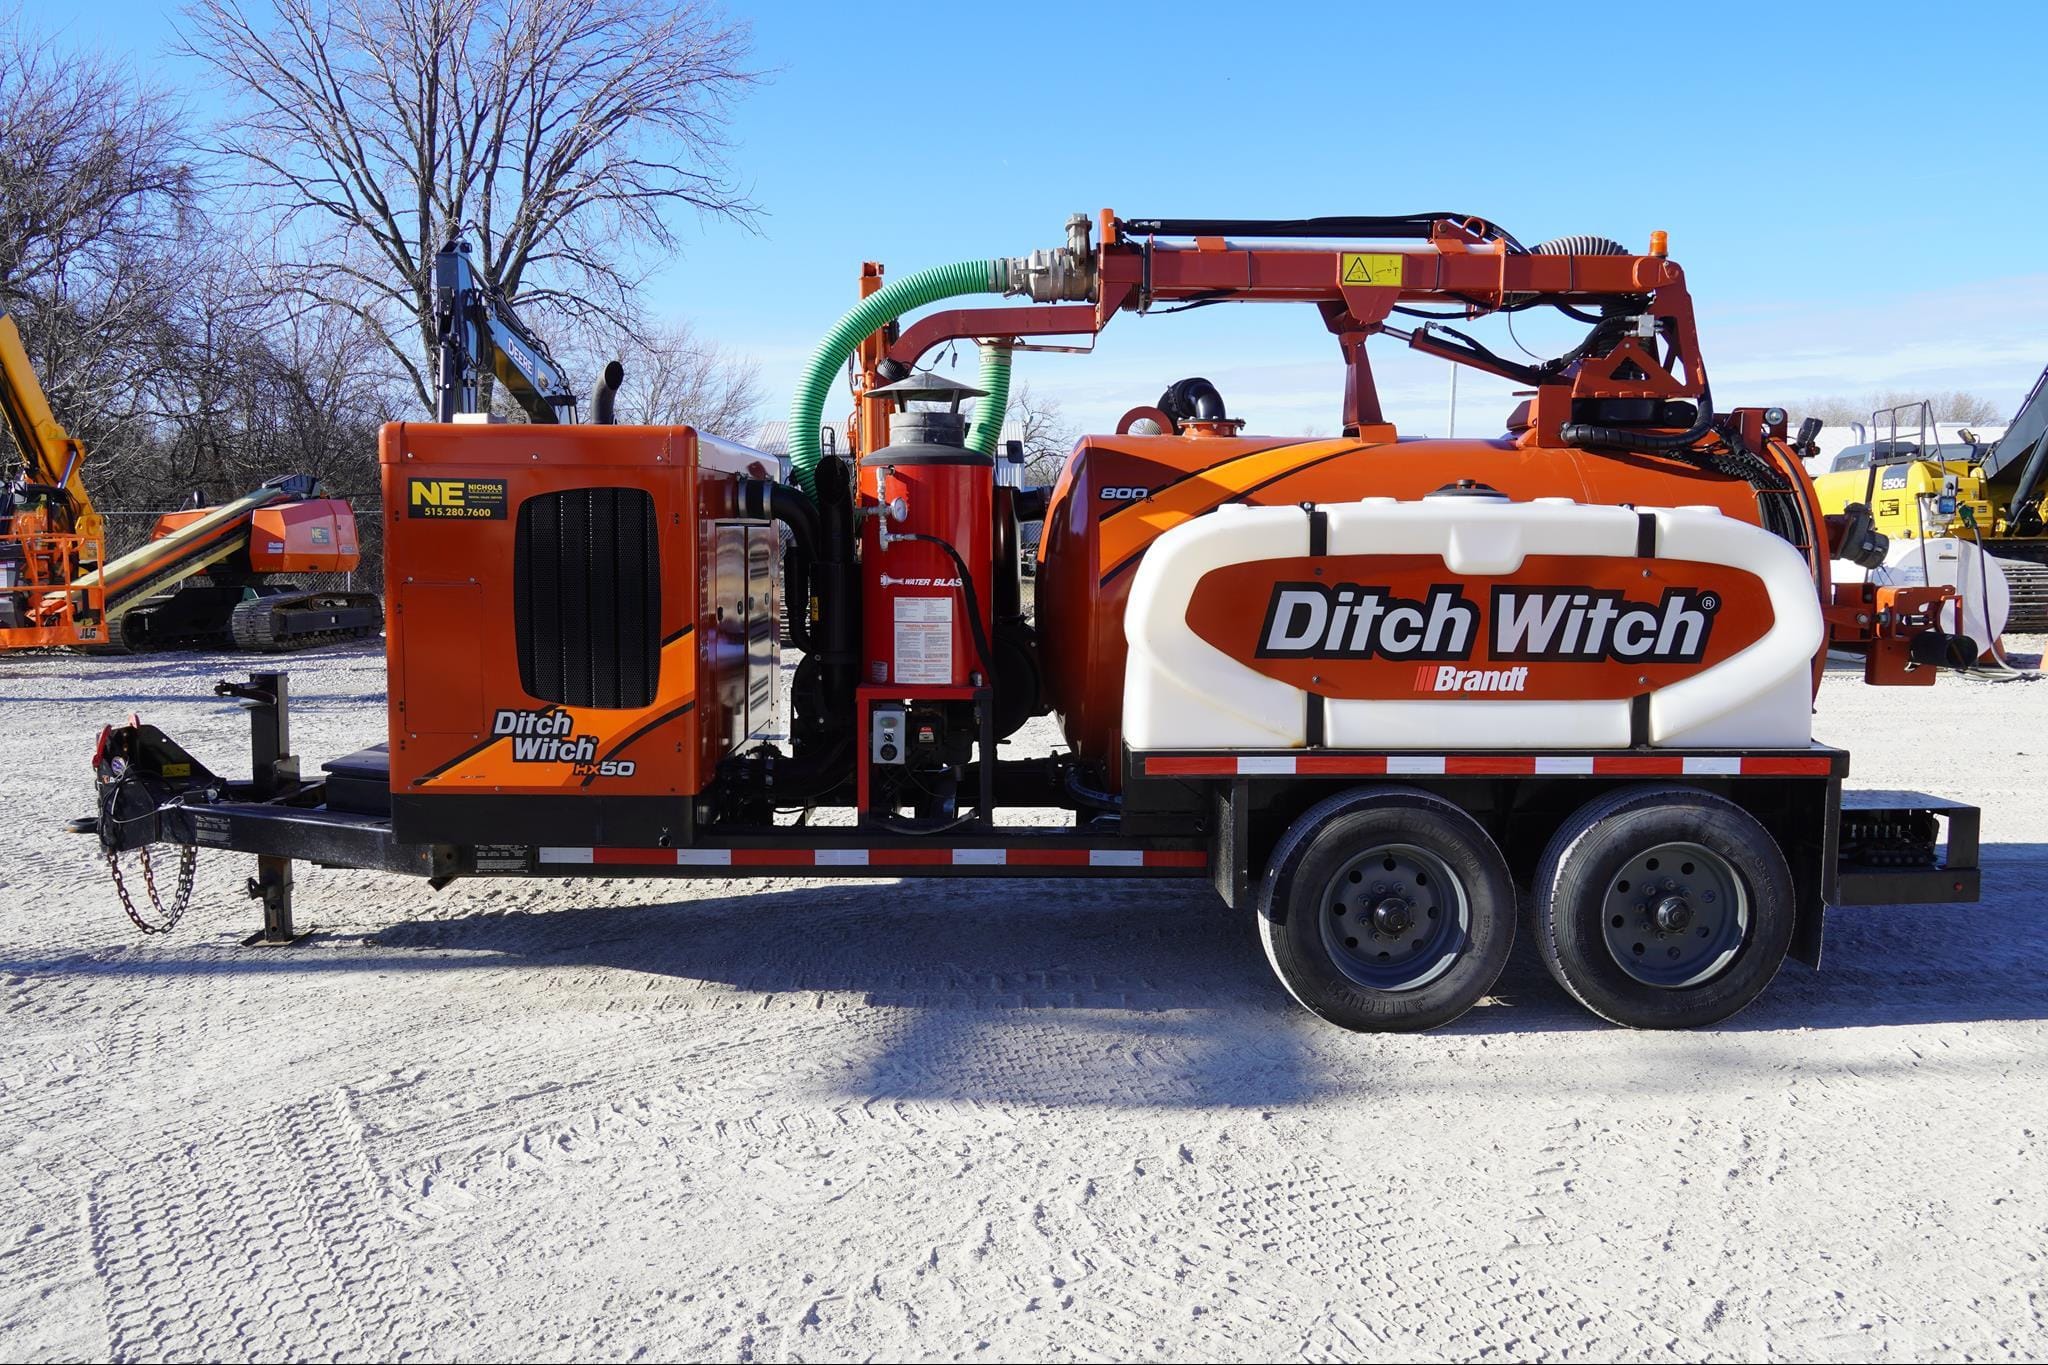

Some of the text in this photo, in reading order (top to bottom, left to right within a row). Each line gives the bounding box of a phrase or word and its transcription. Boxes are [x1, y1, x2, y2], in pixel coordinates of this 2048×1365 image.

[508, 337, 534, 376] DEERE
[1882, 478, 1906, 490] 350G
[411, 481, 465, 506] NE
[1100, 487, 1148, 499] 800
[424, 507, 491, 517] 515.280.7600
[904, 578, 963, 587] WATER BLAS
[1266, 590, 1472, 653] Ditch
[79, 627, 97, 639] JLG
[1434, 665, 1528, 691] Brandt
[494, 711, 572, 735] Ditch
[574, 761, 636, 776] HX50
